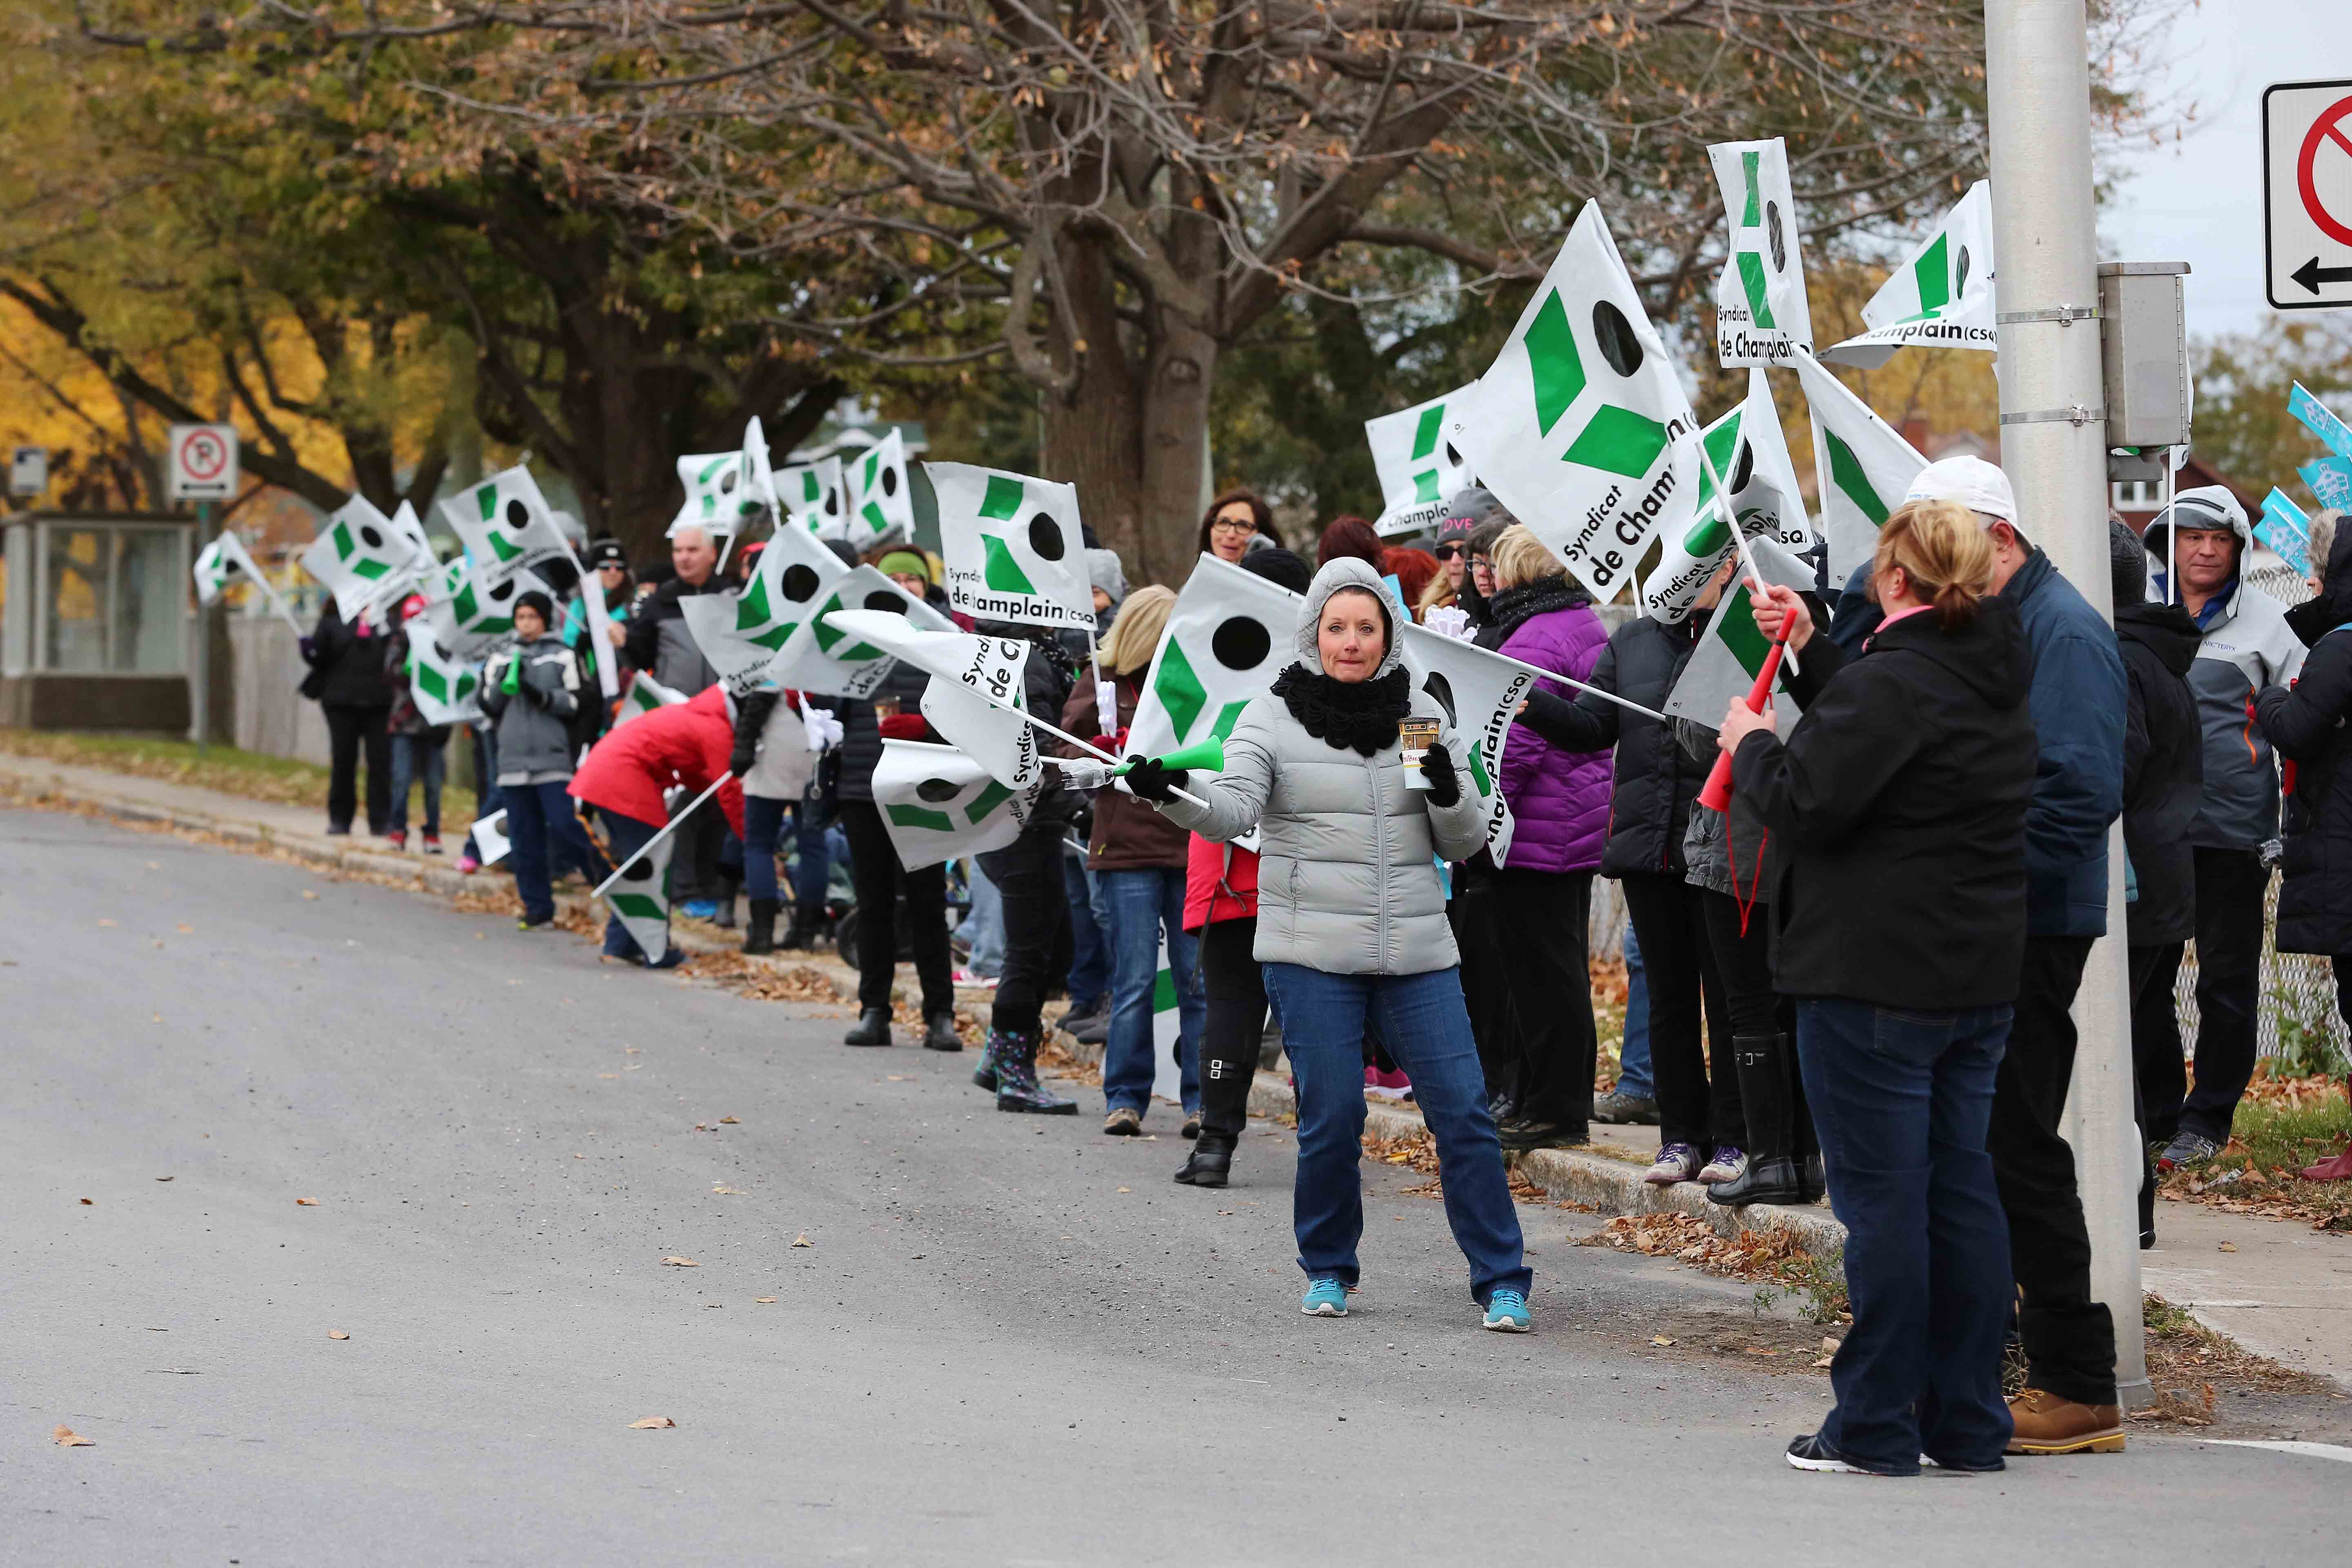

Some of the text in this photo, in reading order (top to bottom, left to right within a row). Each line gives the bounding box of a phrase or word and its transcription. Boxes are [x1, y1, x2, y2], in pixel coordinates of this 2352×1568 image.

[1721, 330, 1732, 357] de
[1439, 517, 1474, 536] OVE
[1564, 485, 1622, 561] Syndicat
[1593, 550, 1623, 586] de
[953, 587, 969, 605] de
[1649, 563, 1706, 609] Syndicat
[1668, 595, 1696, 620] de
[986, 667, 1011, 698] de
